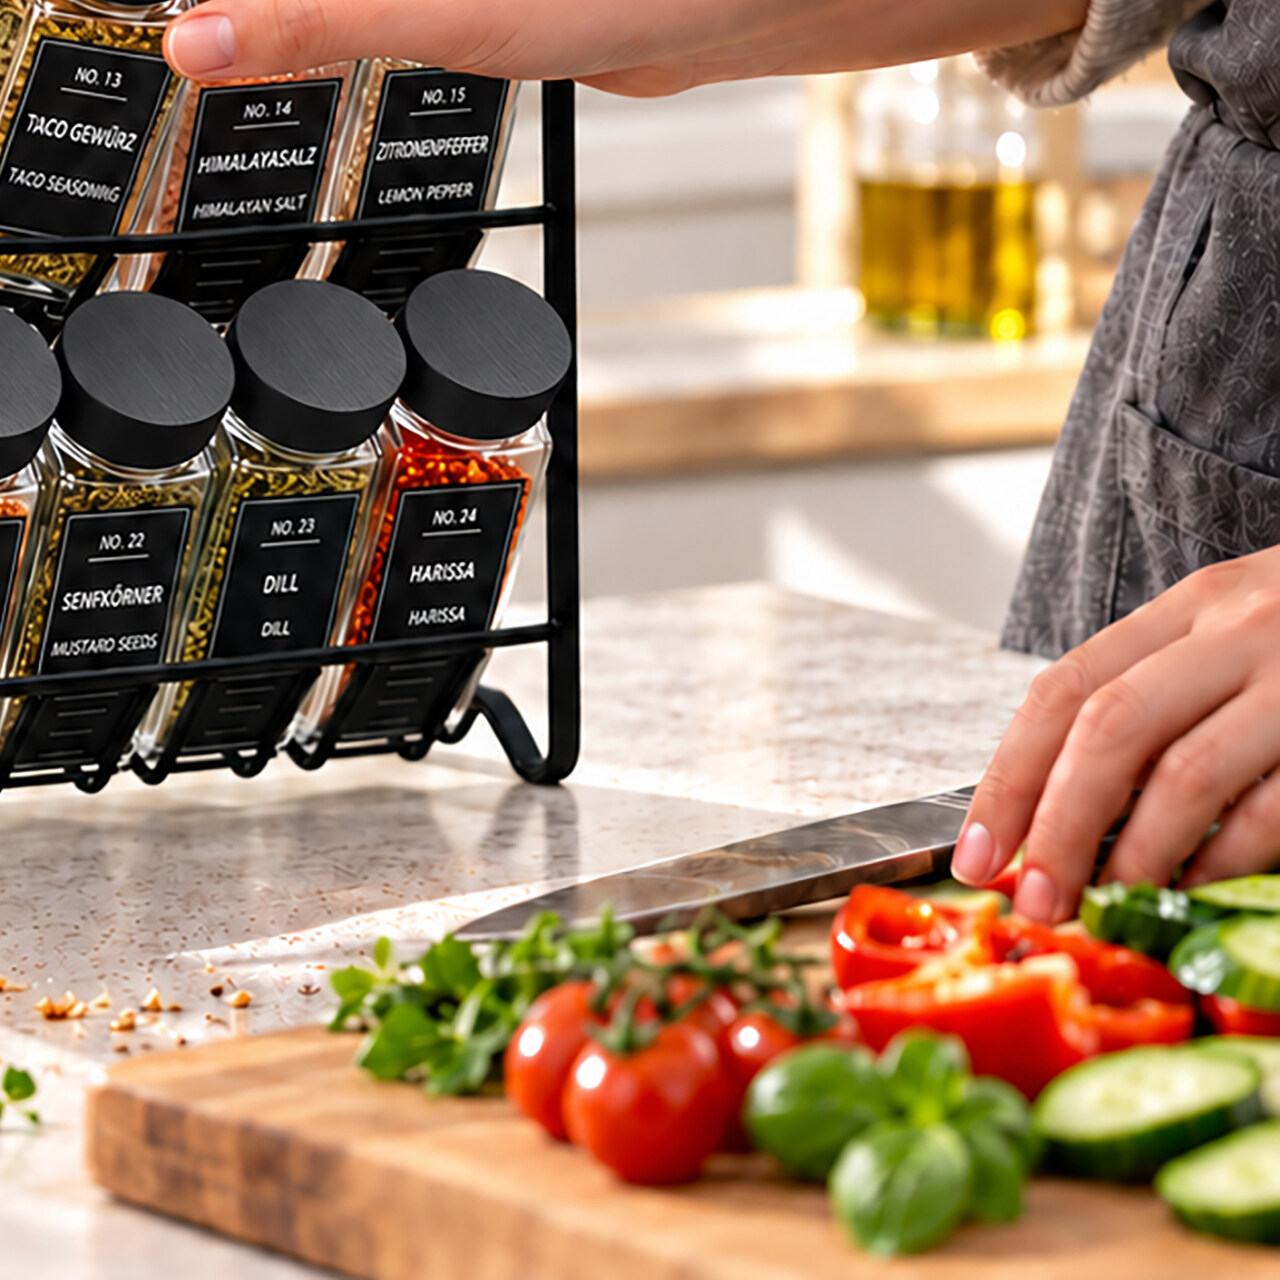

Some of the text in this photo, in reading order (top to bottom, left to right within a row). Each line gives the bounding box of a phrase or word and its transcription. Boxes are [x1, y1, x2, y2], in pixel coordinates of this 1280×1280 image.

[74, 67, 123, 88] NO. 13
[422, 87, 465, 104] NO. 15
[244, 101, 291, 117] NO. 14
[26, 113, 138, 153] TACO GEWÜRZ
[8, 167, 47, 188] TACO
[427, 182, 473, 199] PEPPER
[274, 194, 306, 212] SALT
[433, 508, 476, 524] NO. 24
[272, 518, 315, 535] NO. 23
[100, 533, 144, 549] NO. 22
[410, 562, 474, 582] HARISSA
[264, 574, 298, 593] DILL
[409, 607, 464, 625] HARISSA
[261, 621, 289, 637] DILL
